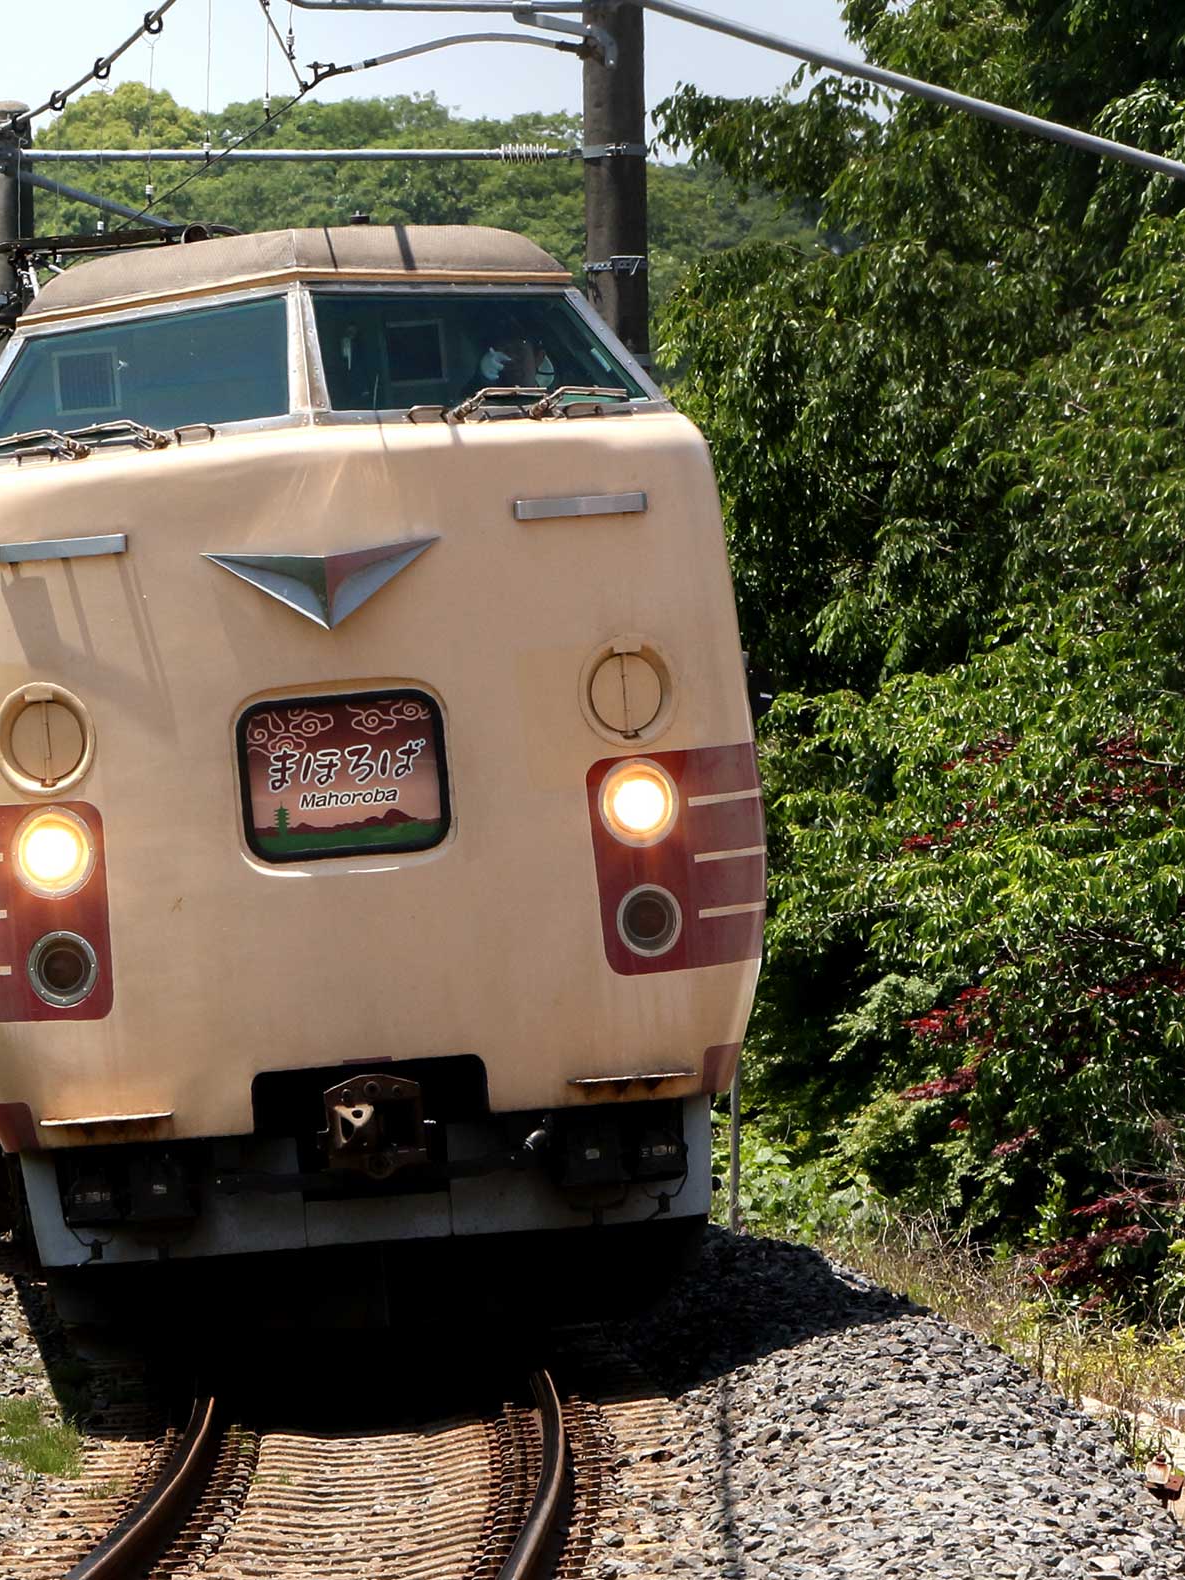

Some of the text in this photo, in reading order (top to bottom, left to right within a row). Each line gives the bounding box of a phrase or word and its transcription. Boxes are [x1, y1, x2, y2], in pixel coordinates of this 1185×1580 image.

[269, 739, 426, 792] まほろば
[299, 787, 399, 809] Mahoroba
